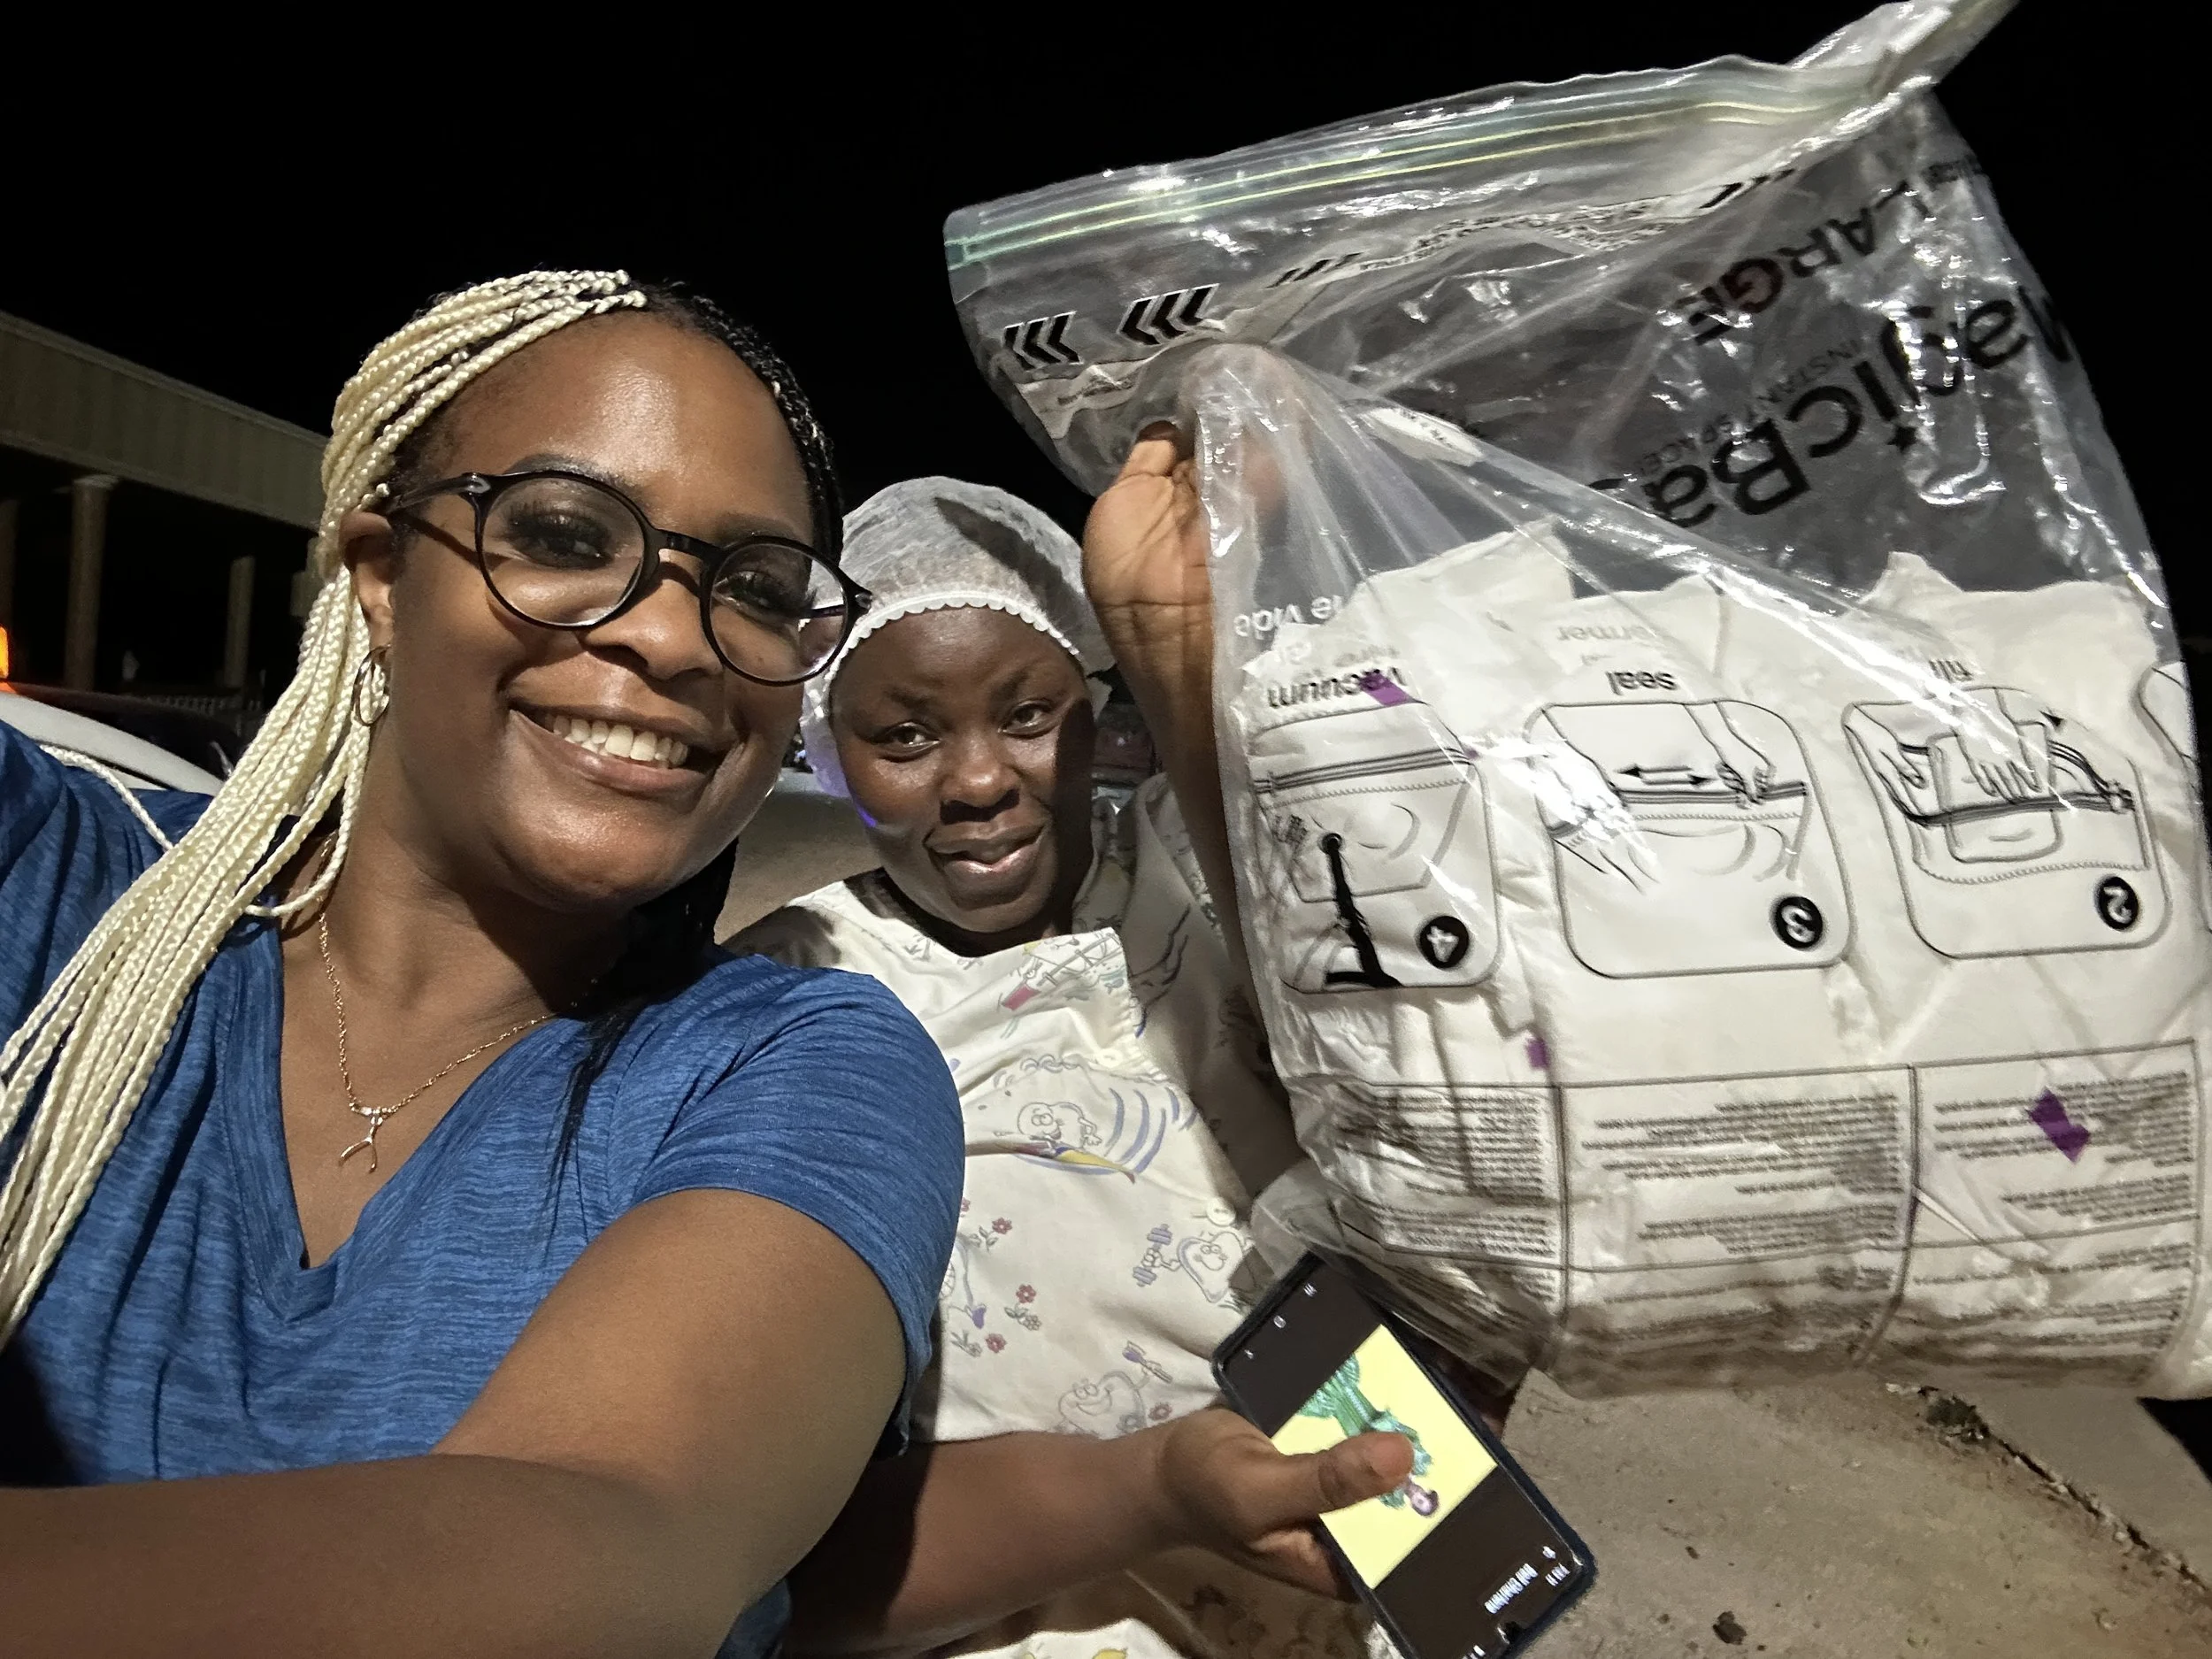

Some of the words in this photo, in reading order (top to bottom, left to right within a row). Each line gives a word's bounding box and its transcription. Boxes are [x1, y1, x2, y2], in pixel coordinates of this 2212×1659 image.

[1675, 180, 1935, 347] LARGE
[1586, 286, 2074, 531] MagicBa
[1265, 666, 1408, 710] vacuum
[1604, 671, 1678, 697] seal
